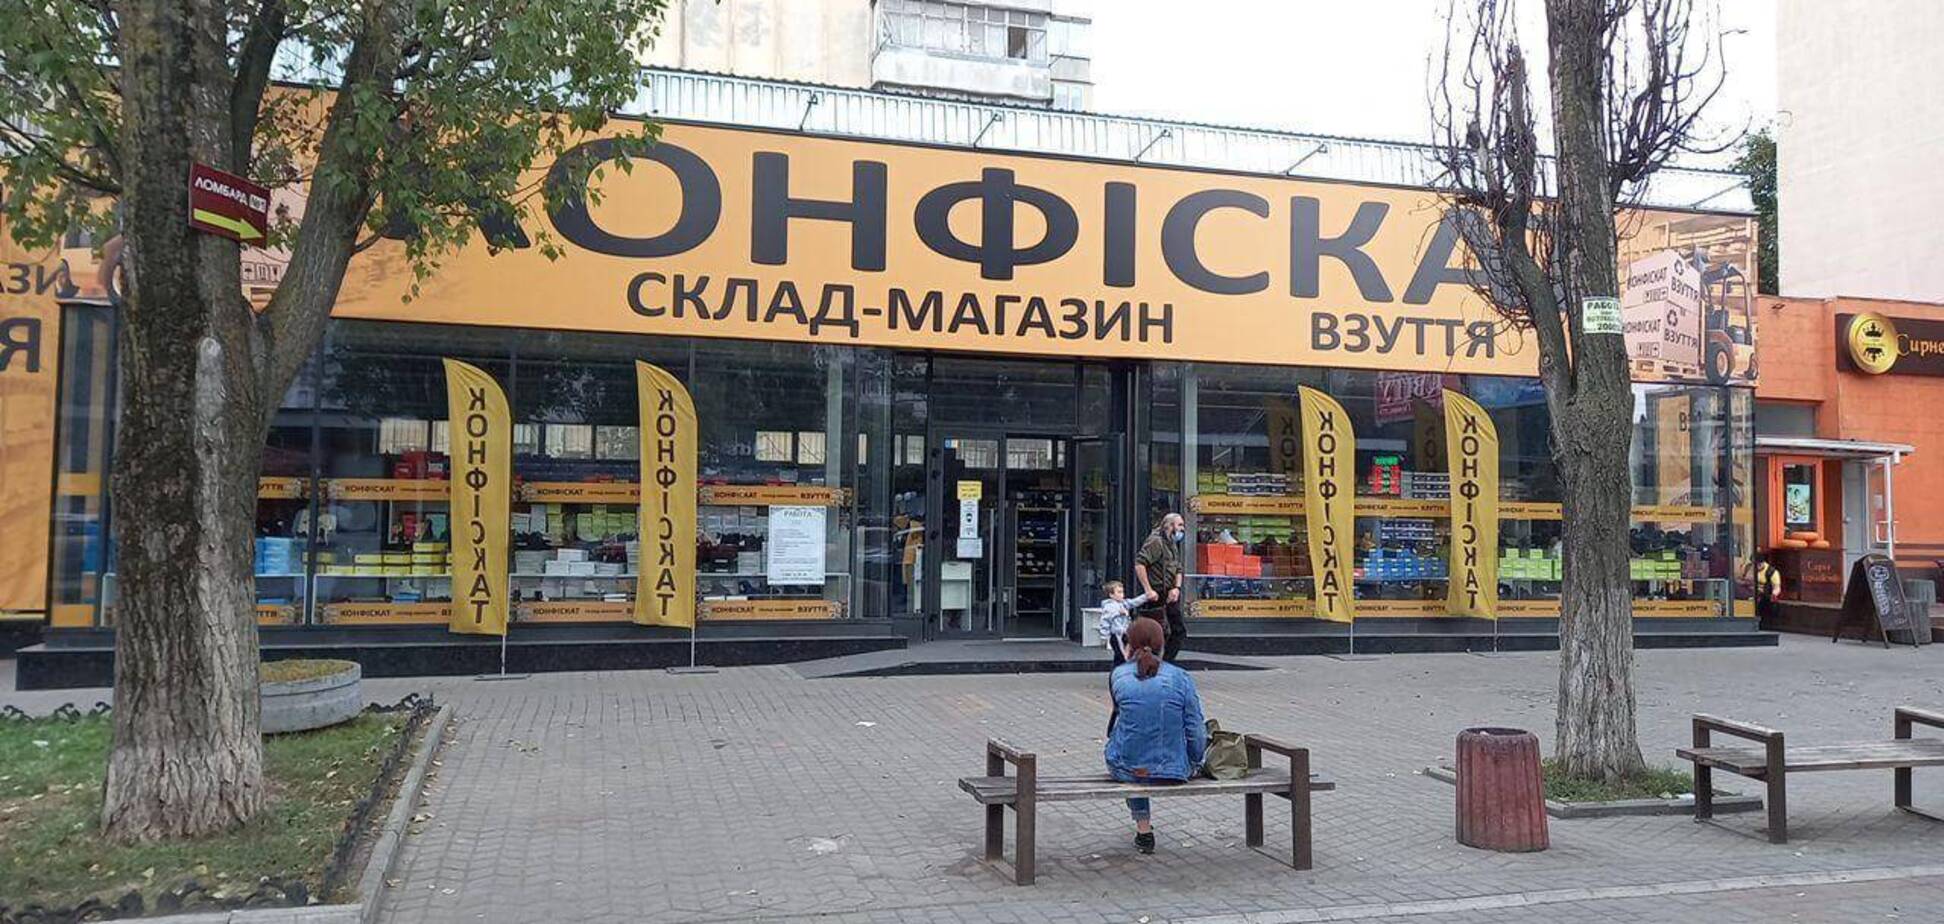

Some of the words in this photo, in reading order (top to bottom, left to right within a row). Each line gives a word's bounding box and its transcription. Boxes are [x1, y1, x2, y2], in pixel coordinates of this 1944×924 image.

[1671, 277, 1699, 300] ВЗУТТЯ
[627, 273, 1173, 346] СКЛАД-МАГАЗИН
[1311, 312, 1495, 358] ВЗУТТЯ
[1664, 330, 1697, 349] ВЗУТТЯ
[345, 485, 395, 493] КОНФІСКАТ
[537, 488, 584, 496] КОНФІСКАТ
[714, 491, 758, 499] КОНФІСКАТ
[340, 609, 391, 617] КОНФІСКАТ
[533, 607, 581, 615] КОНФІСКАТ
